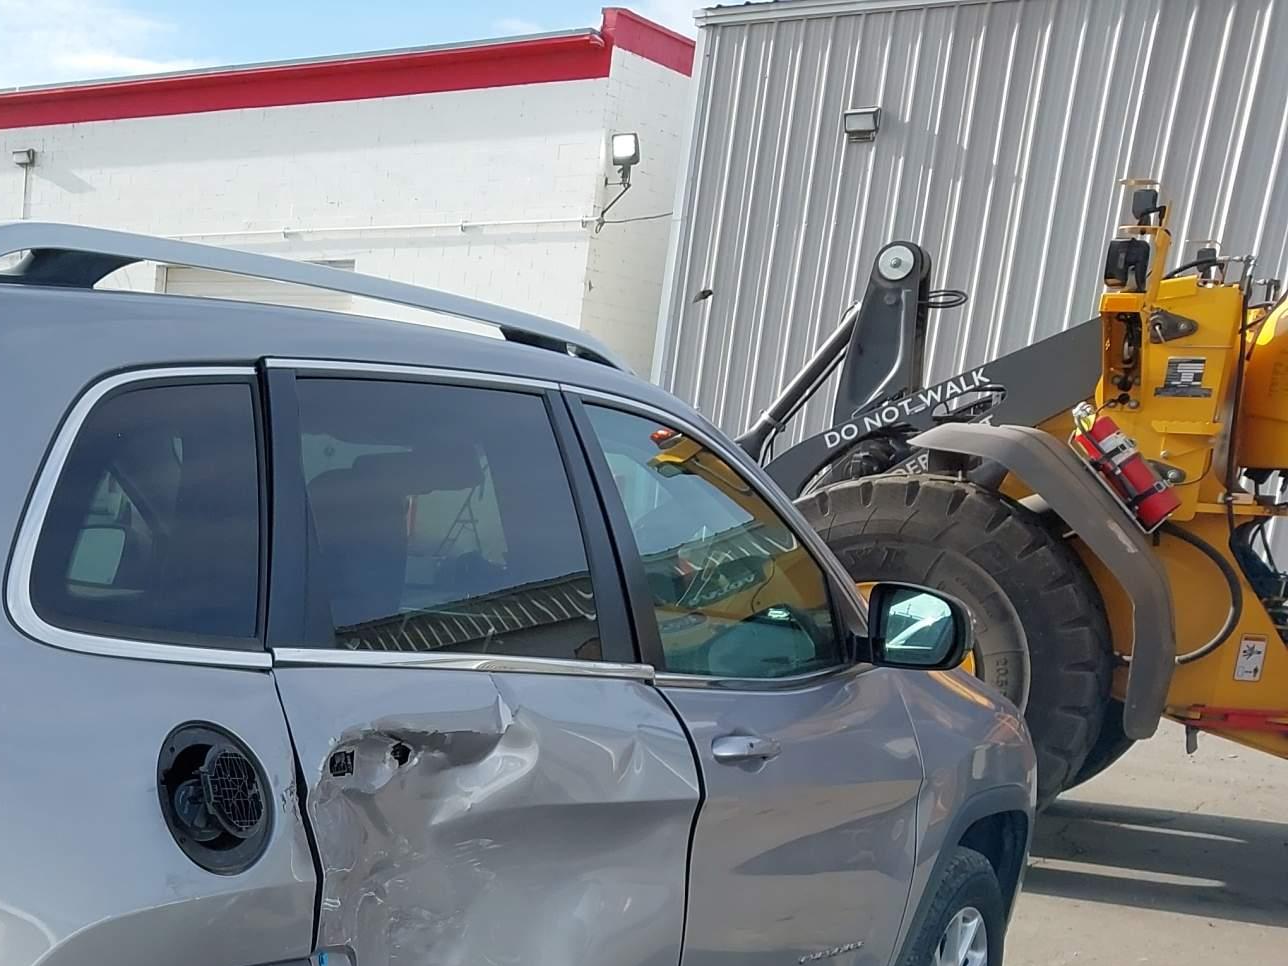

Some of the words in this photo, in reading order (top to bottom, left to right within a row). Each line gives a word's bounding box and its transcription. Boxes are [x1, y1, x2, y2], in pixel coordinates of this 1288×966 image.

[824, 423, 859, 449] DO
[863, 398, 914, 432] NOT
[918, 367, 991, 408] WALK
